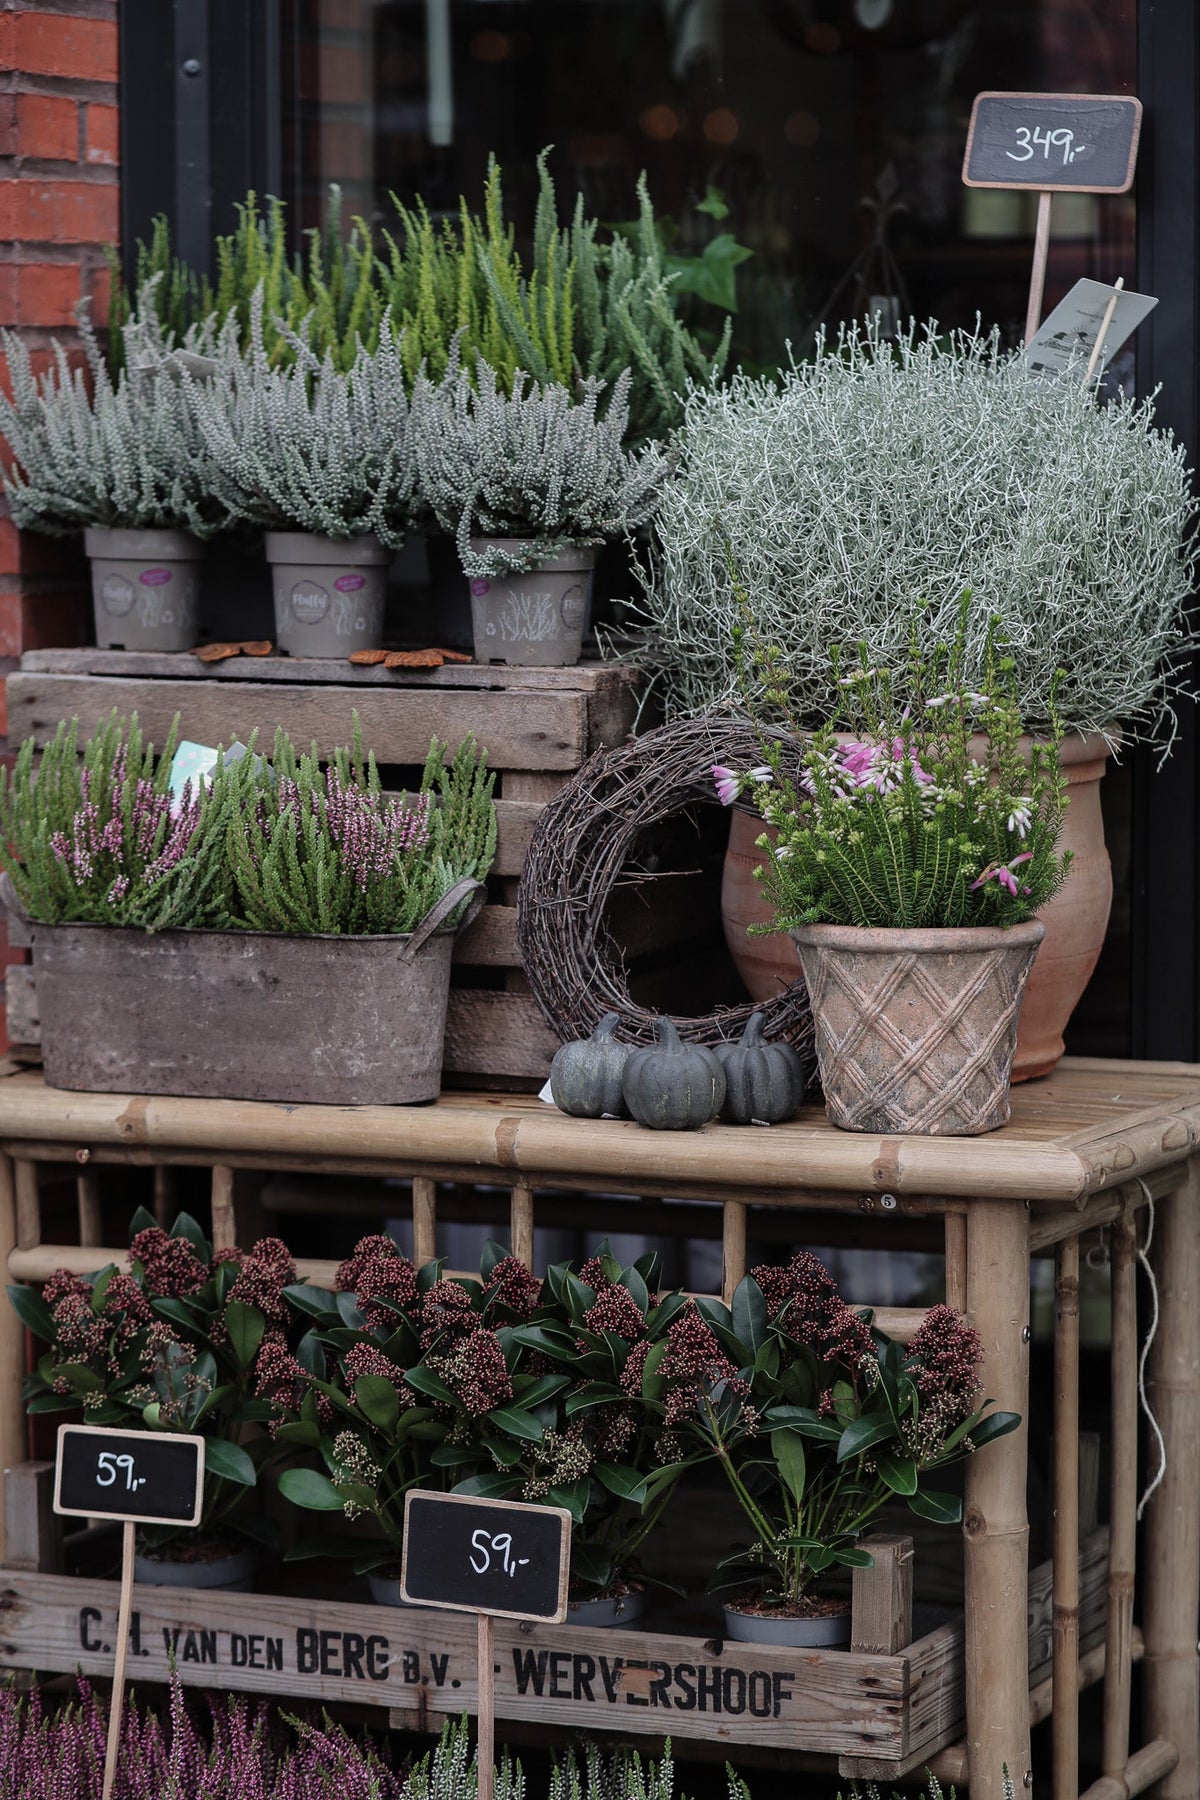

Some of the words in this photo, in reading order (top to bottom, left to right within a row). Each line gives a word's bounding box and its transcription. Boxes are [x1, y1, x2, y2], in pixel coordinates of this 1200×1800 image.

[1006, 126, 1086, 164] 349,-
[96, 1452, 146, 1492] 59,-
[469, 1529, 530, 1577] 59,-
[163, 1628, 217, 1663] VAN
[231, 1634, 283, 1670] DEN
[297, 1628, 389, 1680] BERG
